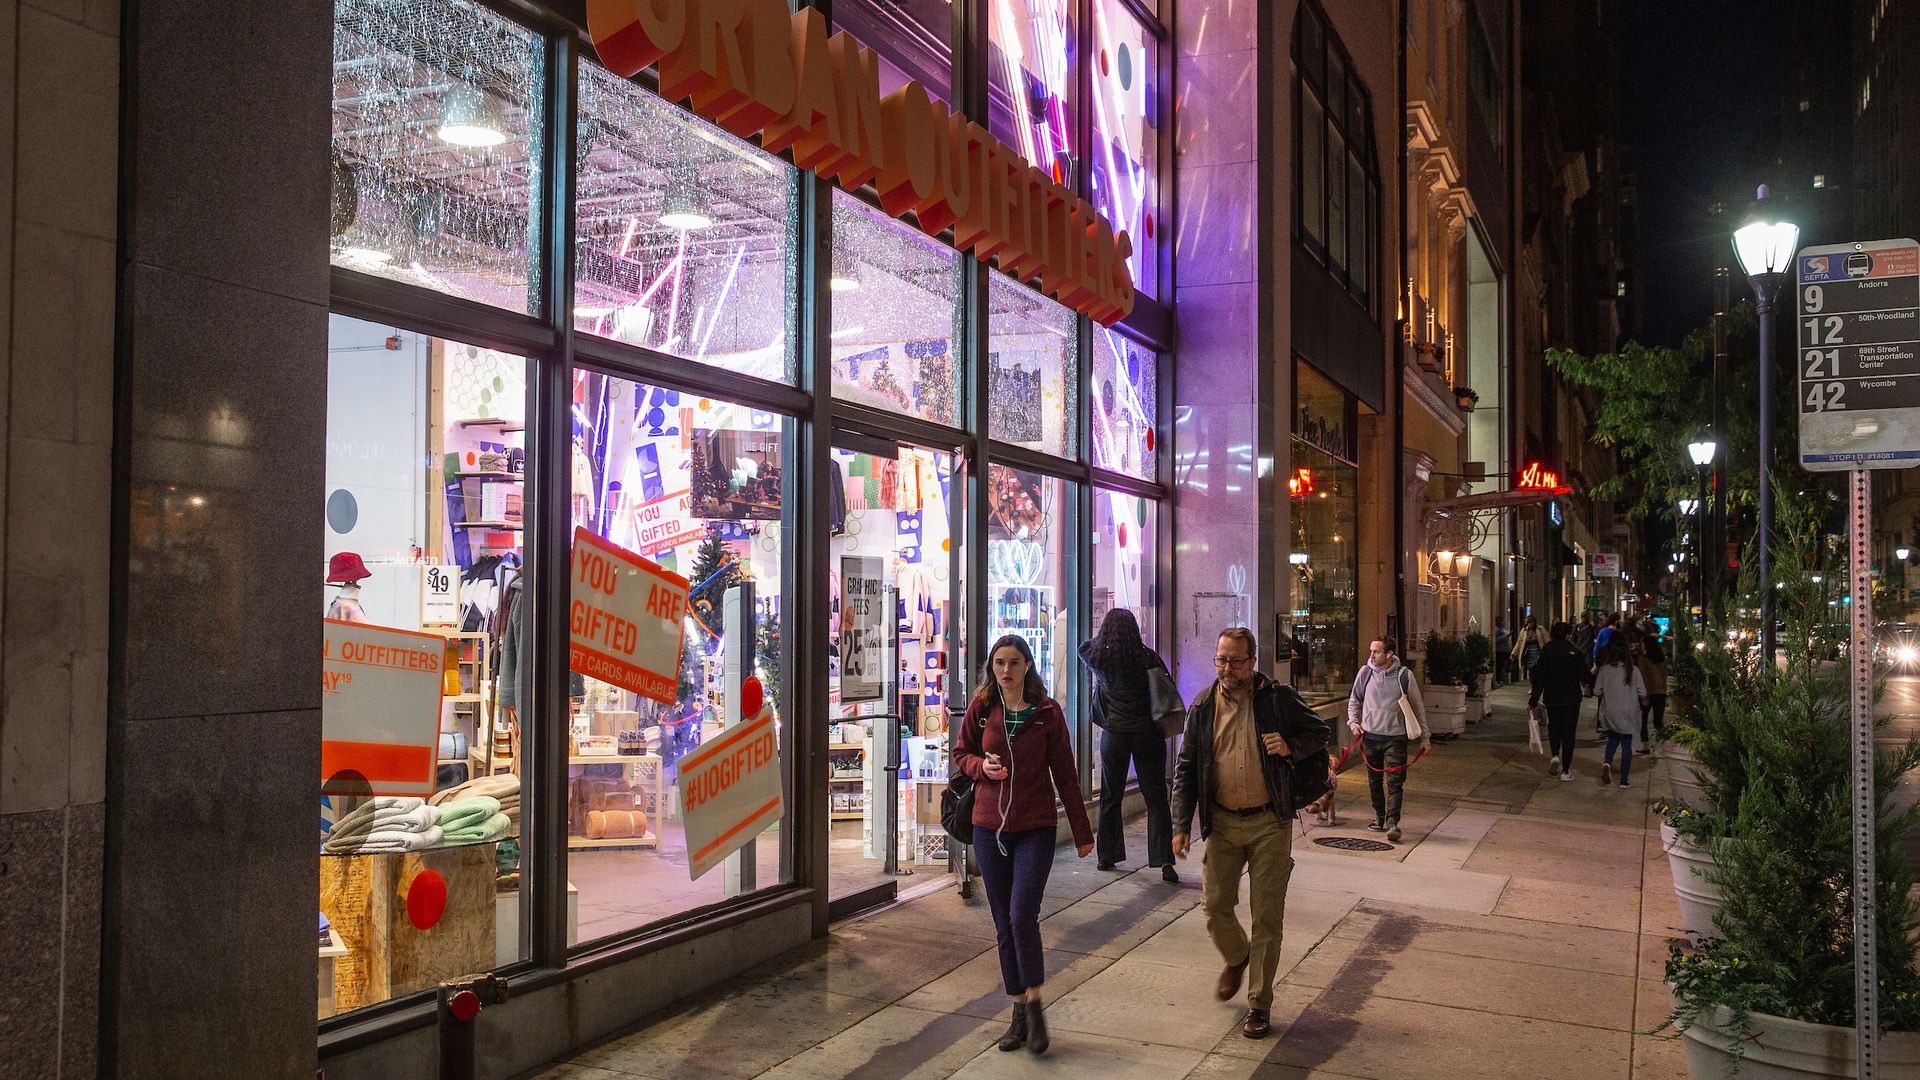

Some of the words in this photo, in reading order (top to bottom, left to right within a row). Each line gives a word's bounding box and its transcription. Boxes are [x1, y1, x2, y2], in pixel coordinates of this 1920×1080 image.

[876, 80, 1134, 328] OUTFITTERS
[1804, 273, 1829, 281] SEPTA
[1804, 285, 1824, 314] 9
[1858, 280, 1889, 289] Andorra
[1804, 316, 1844, 345] 12
[1858, 311, 1915, 322] 50th-Woodland
[1859, 346, 1876, 354] 69th
[1877, 345, 1900, 353] Street
[1805, 349, 1840, 378] 21
[1859, 352, 1914, 363] Transportation
[1859, 361, 1885, 369] Center
[1806, 381, 1846, 411] 42
[1860, 379, 1897, 389] Wycombe
[759, 442, 779, 453] GIFT
[637, 505, 660, 525] YOU
[640, 519, 681, 543] GIFTED
[656, 537, 678, 551] CARDS
[427, 575, 449, 593] $49
[579, 547, 618, 597] YOU
[646, 583, 682, 625] ARE
[847, 577, 878, 595] GRAPHIC
[853, 598, 870, 615] TEES
[571, 599, 638, 656] GIFTED
[341, 641, 439, 671] OUTFITTERS
[844, 629, 866, 677] 25
[586, 652, 623, 681] CARDS
[624, 668, 675, 700] AVAILABLE
[867, 663, 877, 676] OFF
[686, 730, 773, 814] #UOGIFTED
